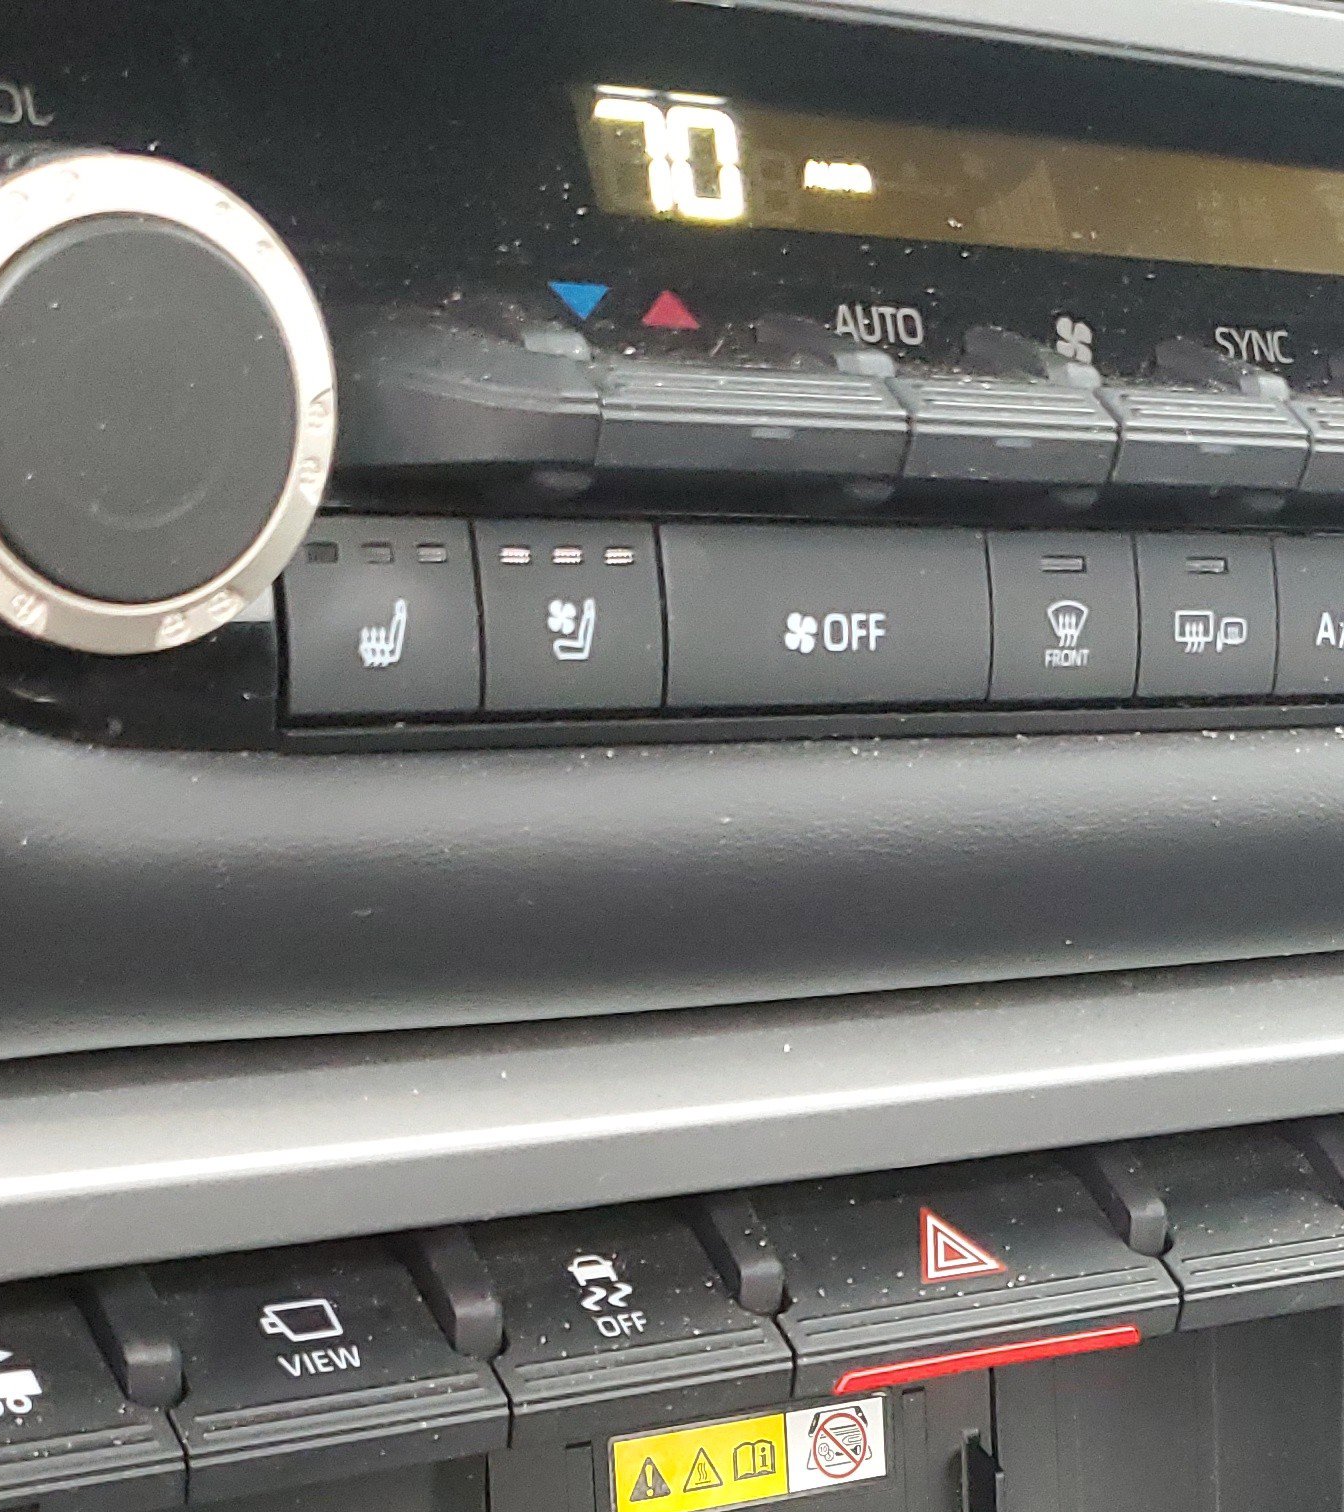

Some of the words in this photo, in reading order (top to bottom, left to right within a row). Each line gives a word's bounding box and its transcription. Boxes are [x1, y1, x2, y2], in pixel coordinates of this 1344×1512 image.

[593, 98, 745, 221] 70
[834, 303, 925, 346] AUTO
[1214, 327, 1294, 366] SYNC
[824, 613, 886, 652] OFF
[1045, 648, 1089, 668] FRONT
[596, 1310, 647, 1338] OFF
[276, 1345, 362, 1378] VIEW
